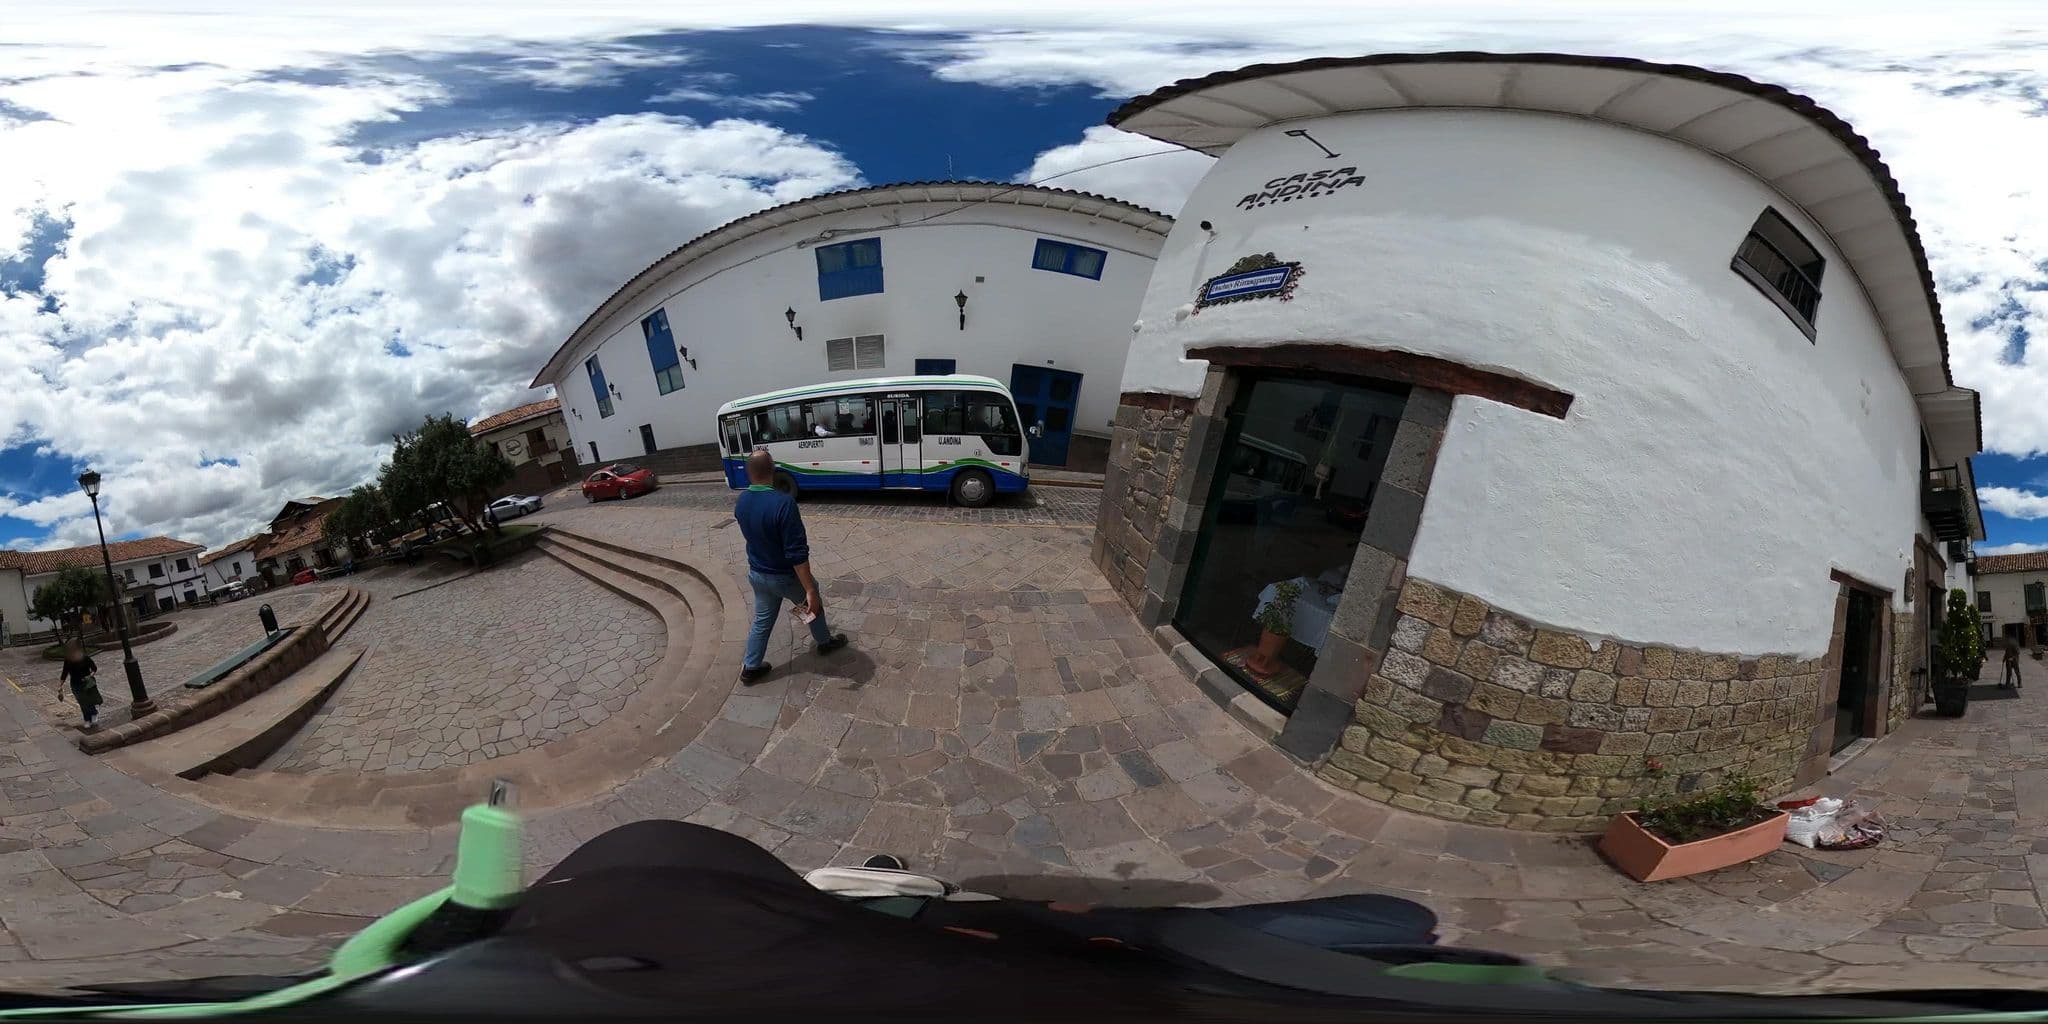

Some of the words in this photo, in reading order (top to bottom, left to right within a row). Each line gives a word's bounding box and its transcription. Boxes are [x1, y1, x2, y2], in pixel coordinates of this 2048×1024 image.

[1264, 167, 1357, 189] CASA
[1236, 176, 1366, 208] ANDINA
[798, 440, 825, 449] AEROPUERTO
